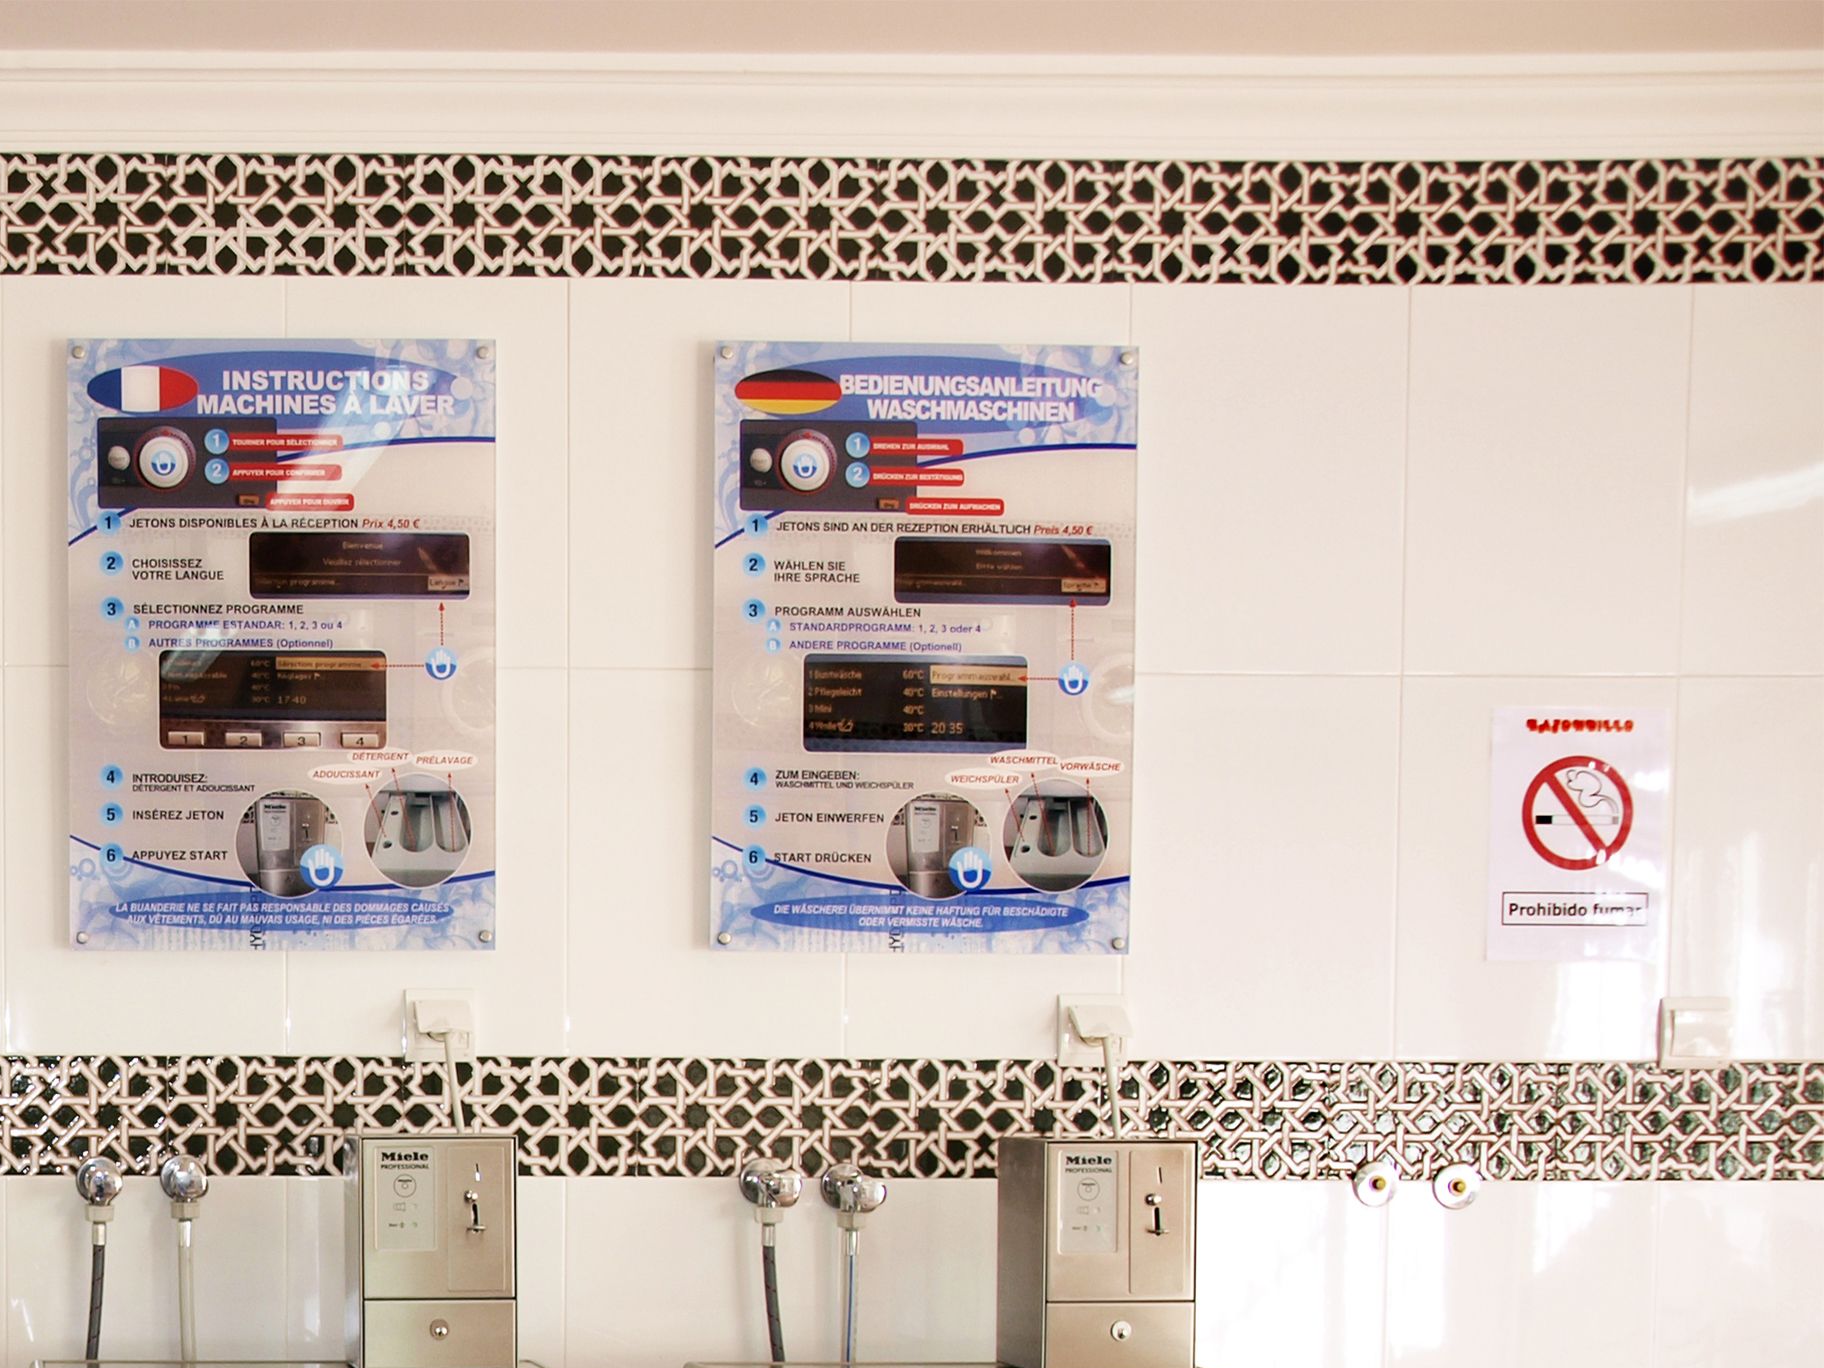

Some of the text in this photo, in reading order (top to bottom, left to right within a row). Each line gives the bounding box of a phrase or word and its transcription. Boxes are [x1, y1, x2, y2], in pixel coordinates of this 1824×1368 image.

[223, 370, 429, 390] INSTRUCTIONS
[840, 374, 1102, 398] BEDIENUNGSANLEITUNG
[197, 388, 454, 415] MACHINES À LAVER
[867, 399, 1074, 422] WASCHMASCHINEN
[129, 518, 175, 529] JETONS
[179, 518, 257, 529] DISPONIBLES
[273, 518, 288, 528] LA
[291, 515, 357, 528] RÉCEPTION
[362, 518, 384, 528] Prix
[387, 518, 409, 530] 4,50
[411, 518, 420, 528] €
[776, 522, 820, 532] JETONS
[823, 522, 851, 532] SIND
[853, 522, 867, 532] AN
[871, 522, 893, 532] DER
[897, 522, 958, 533] REZEPTION
[962, 522, 1031, 534] ERHÄLTLICH
[1034, 524, 1059, 534] Preis
[1062, 525, 1084, 536] 4,50
[132, 558, 202, 569] CHOISISSEZ
[774, 558, 845, 571] WÄHLEN SIE
[132, 570, 224, 581] VOTRE LANGUE
[774, 572, 860, 583] IHRE SPRACHE
[133, 601, 303, 614] SÉLECTIONNEZ PROGRAMME
[775, 604, 921, 617] PROGRAMM AUSWÄHLEN
[148, 638, 333, 649] AUTRES PROGRAMMES (Optionnel)
[789, 641, 962, 652] ANDERE PROGRAMME (Optionell)
[990, 756, 1058, 765] WASCHMITTEL
[132, 773, 208, 783] INTRODUISEZ:
[313, 769, 380, 779] ADOUCISSANT
[776, 770, 860, 780] ZUM EINGEBEN:
[132, 808, 224, 820] INSÉREZ JETON
[775, 813, 884, 823] JETON EINWERFEN
[132, 850, 228, 861] APPUYEZ START
[774, 851, 871, 863] START DRÜCKEN
[1509, 903, 1587, 916] Prohibido
[381, 1152, 429, 1161] Miele
[1065, 1156, 1112, 1165] Miele
